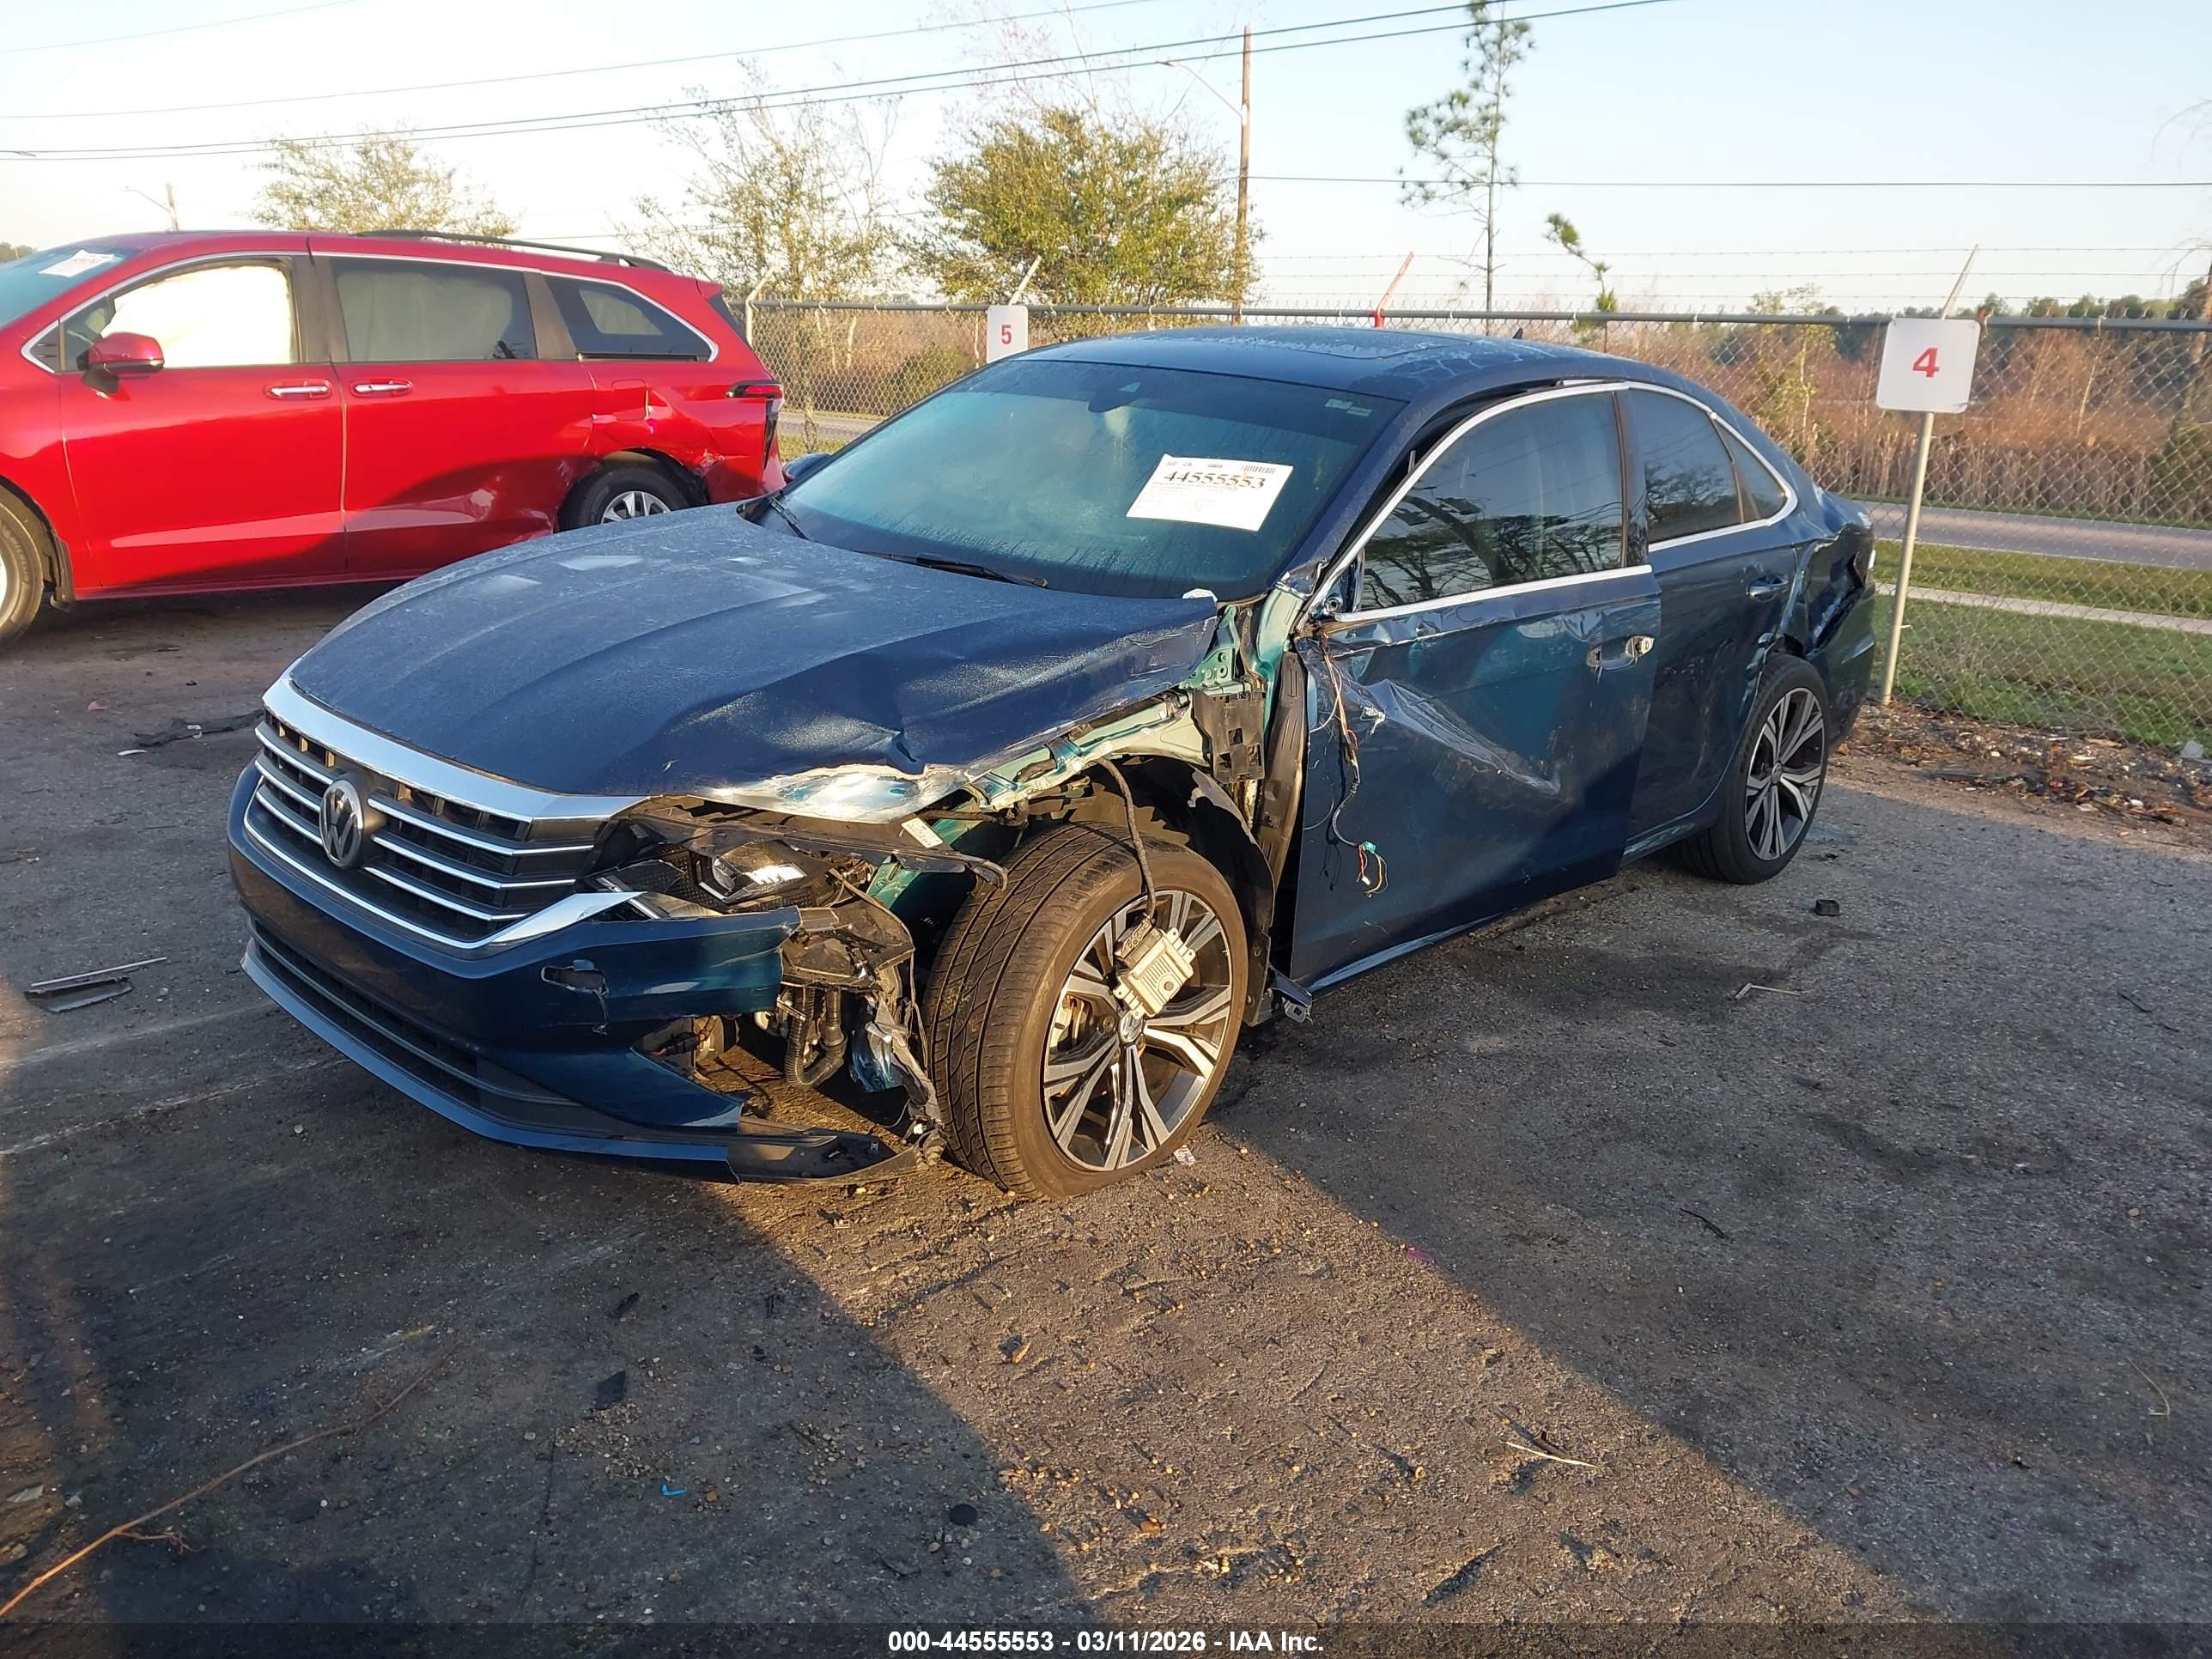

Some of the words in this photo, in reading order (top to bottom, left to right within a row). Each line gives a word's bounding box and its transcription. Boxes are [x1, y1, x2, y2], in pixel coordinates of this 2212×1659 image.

[1001, 325, 1012, 345] 5
[1912, 347, 1939, 378] 4
[1164, 471, 1267, 489] 44555553
